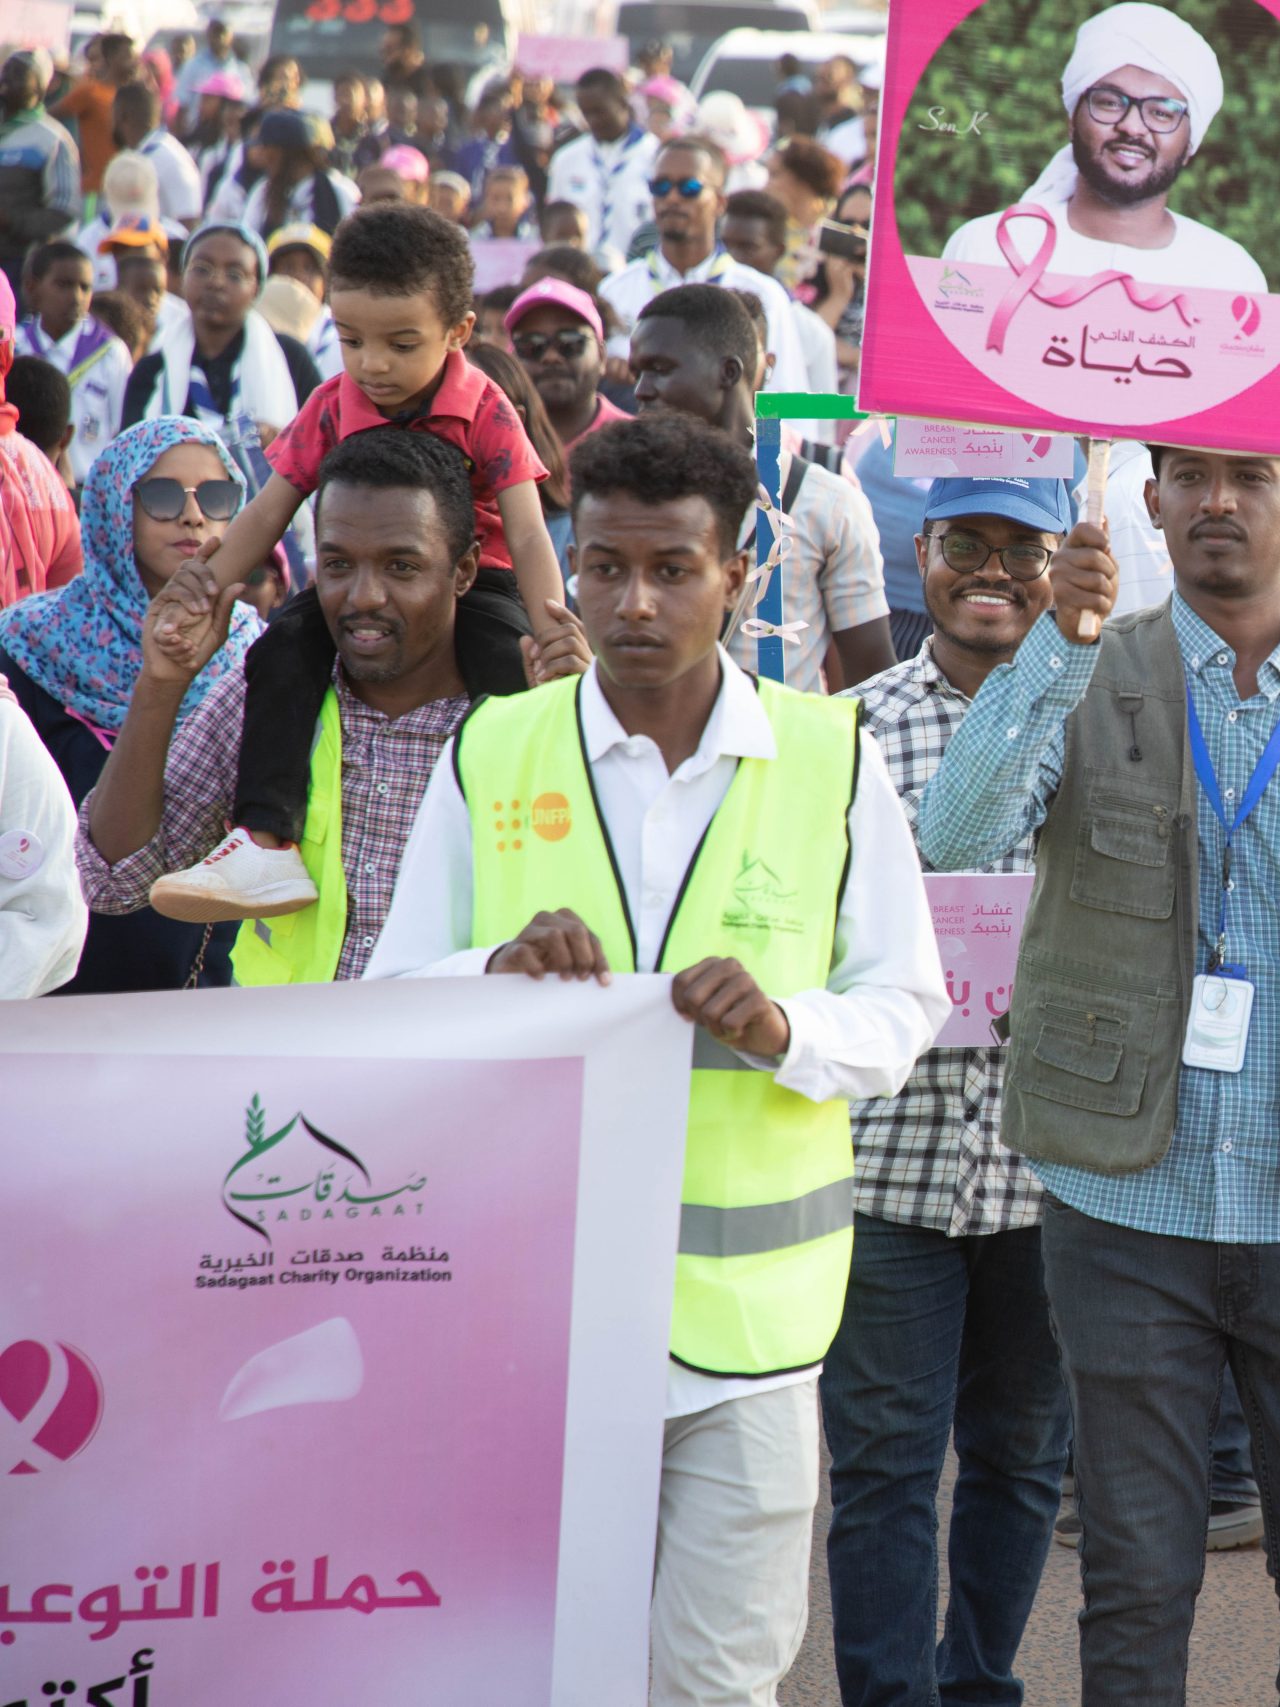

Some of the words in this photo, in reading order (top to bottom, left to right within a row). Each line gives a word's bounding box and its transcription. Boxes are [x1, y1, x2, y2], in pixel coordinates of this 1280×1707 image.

[1138, 333, 1196, 349] الكشف
[1041, 324, 1193, 385] حياة
[920, 436, 956, 444] CANCER
[904, 447, 958, 456] AWARENESS
[933, 905, 965, 913] BREAST
[934, 927, 967, 936] RENESS
[256, 1203, 425, 1222] SADAGAAT
[199, 1251, 275, 1274] الخيرية
[290, 1249, 364, 1265] صدقات
[381, 1246, 450, 1263] منظمة
[195, 1273, 274, 1290] Sadagaat
[279, 1268, 340, 1286] Charity
[344, 1267, 453, 1285] Organization
[251, 1555, 442, 1615] حملة
